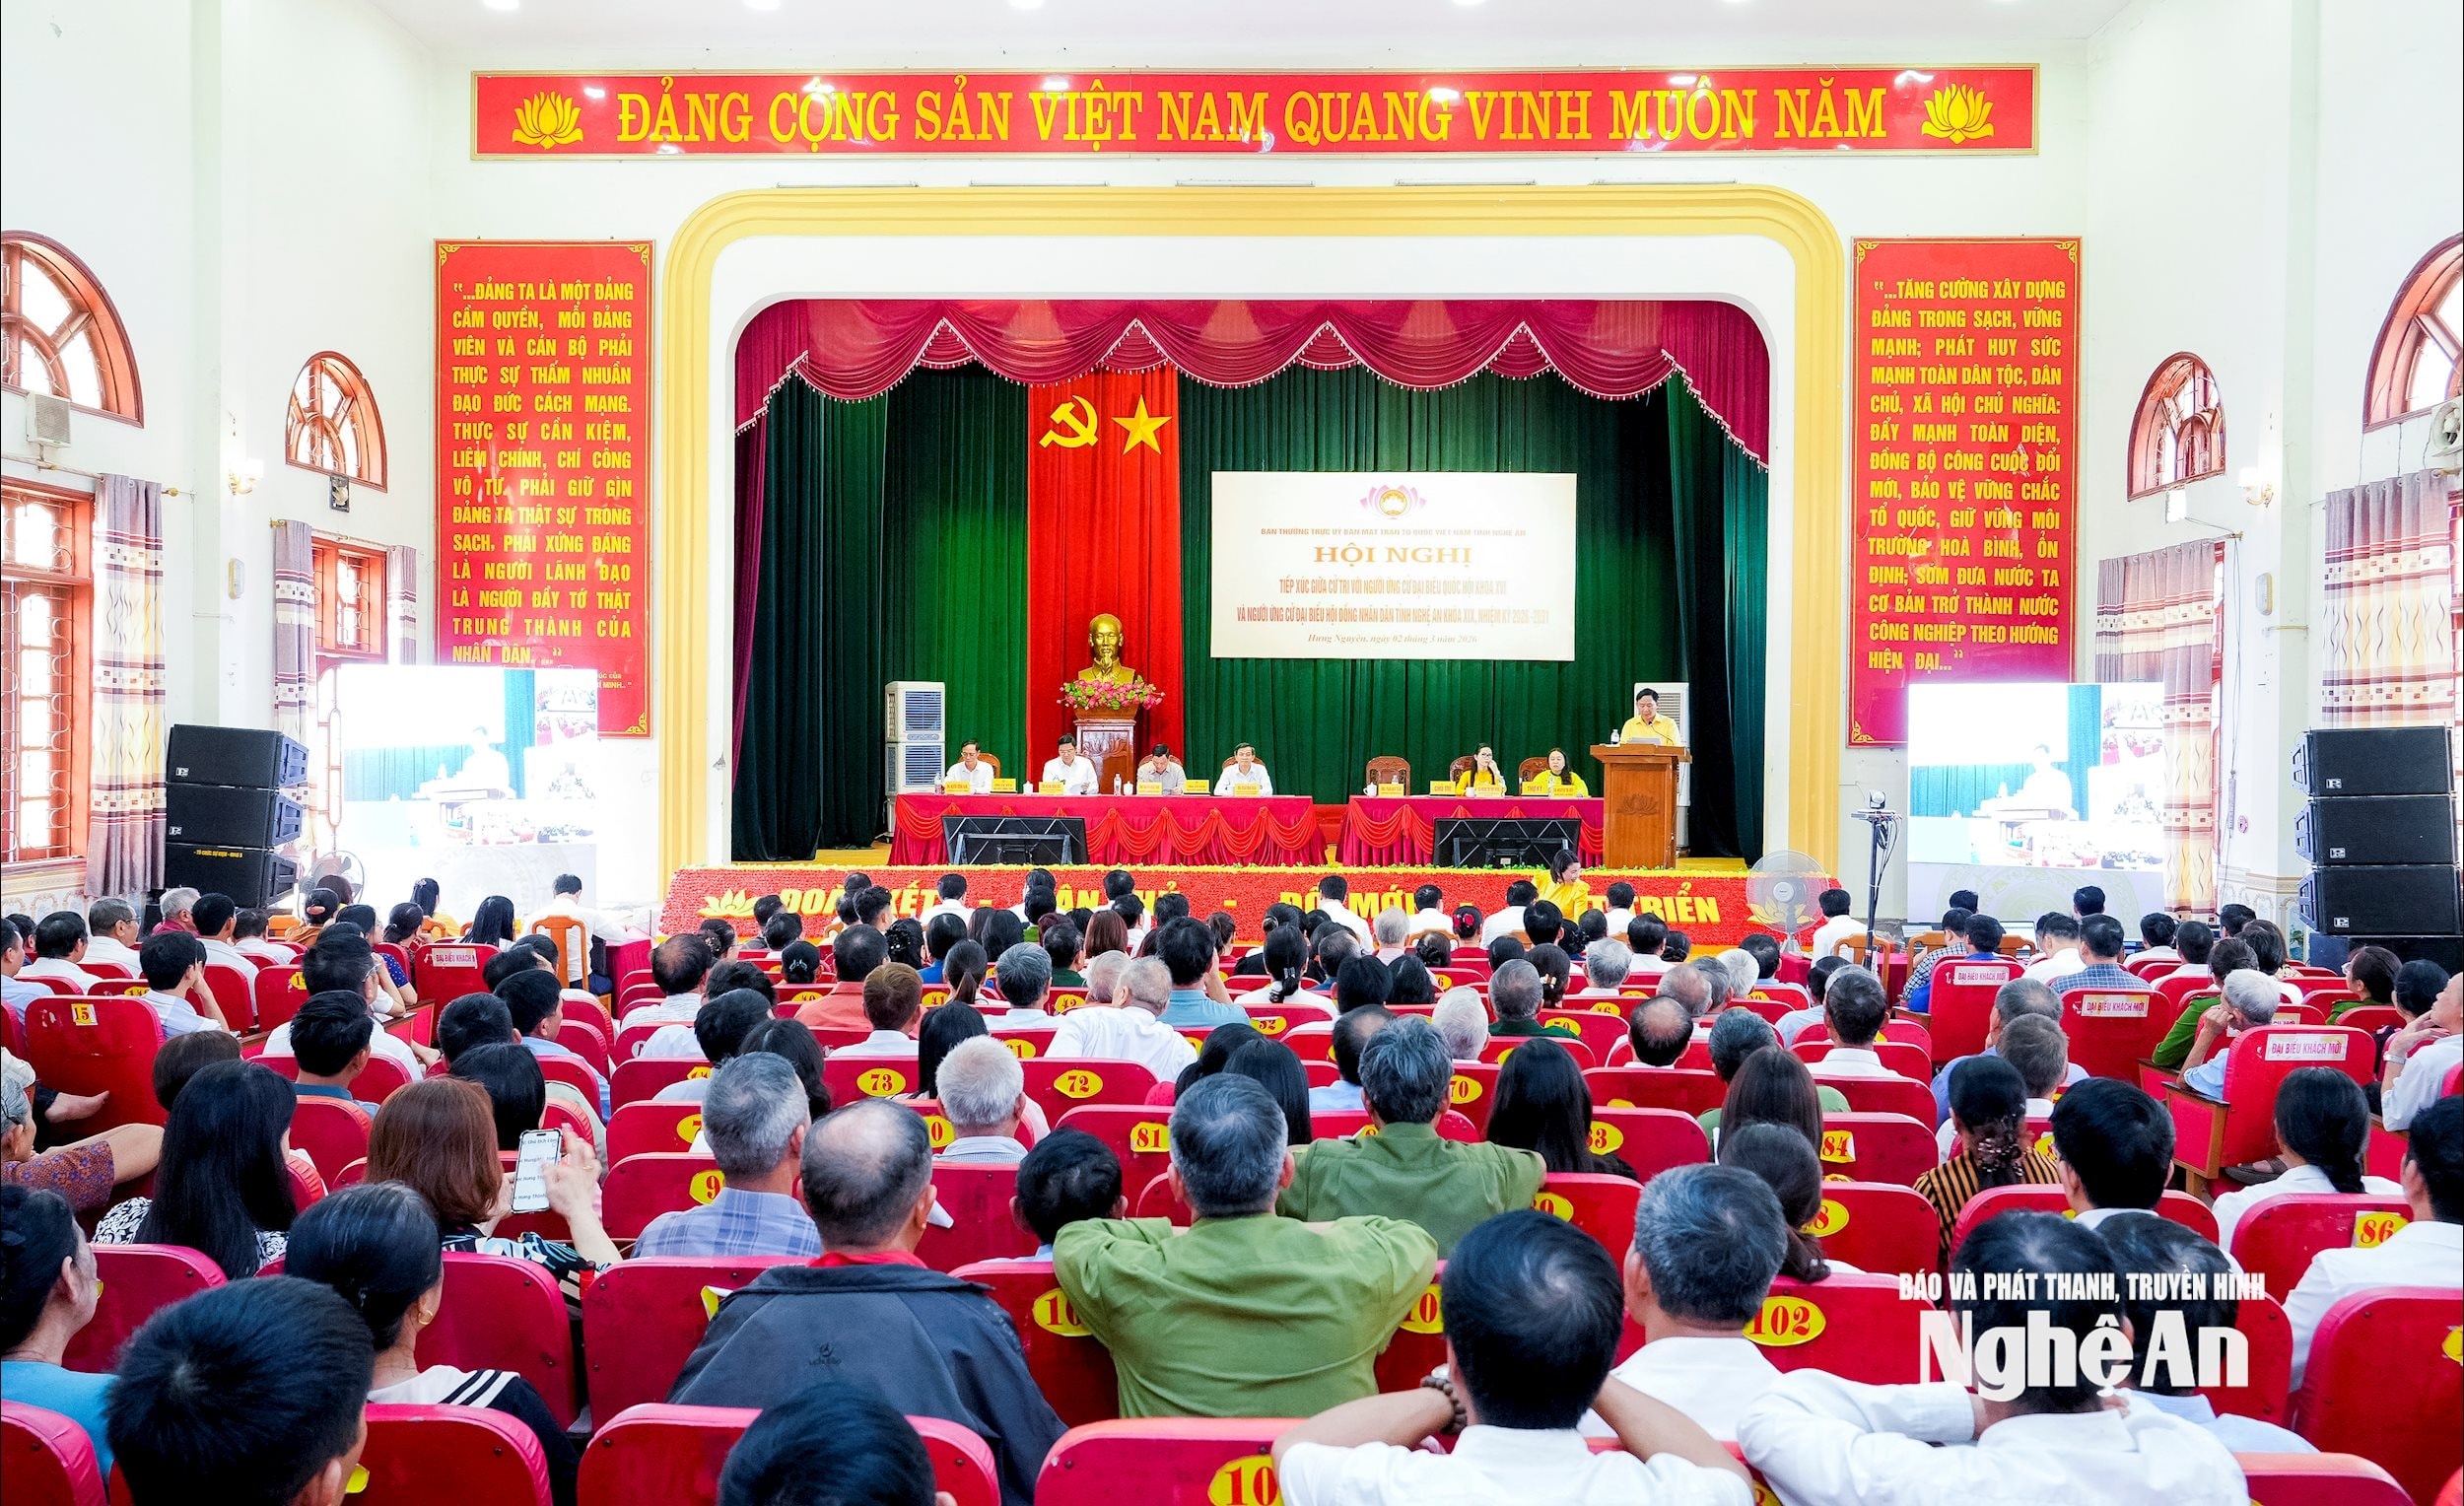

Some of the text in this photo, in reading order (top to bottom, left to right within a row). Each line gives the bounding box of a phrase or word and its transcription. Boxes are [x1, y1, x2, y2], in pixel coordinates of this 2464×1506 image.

[617, 73, 1886, 153] ĐẢNG CỘNG SẢN VIỆT NAM QUANG VINH MUÔN NĂM
[453, 276, 633, 304] “...ĐẢNG TA LÀ MỘT ĐẢNG
[1875, 278, 2065, 302] “...TĂNG CƯỜNG XÂY DỰNG
[453, 303, 632, 330] CẦM QUYỀN, MỖI ĐẢNG
[1872, 304, 2062, 329] ĐẢNG TRONG SẠCH, VỮNG
[453, 332, 632, 359] VIÊN VÀ CÁN BỘ PHẢI
[1872, 334, 2061, 359] MẠNH; PHÁT HUY SỨC
[452, 361, 631, 387] THỰC SỰ THẤM NHUẦN
[1872, 364, 2061, 386] MẠNH TOÀN DÂN TỘC, DÂN
[452, 391, 631, 416] ĐẠO ĐỨC CÁCH MẠNG.
[1871, 392, 2060, 416] CHỦ, XÃ HỘI CHỦ NGHĨA:
[453, 417, 631, 444] THỰC SỰ CẦN KIỆM,
[1870, 417, 2060, 445] ĐẨY MẠNH TOÀN DIỆN,
[453, 447, 632, 469] LIÊM CHÍNH, CHÍ CÔNG
[1870, 447, 2060, 473] ĐỒNG BỘ CÔNG CUỘC ĐỔI
[1313, 542, 1472, 568] HỘI NGHỊ
[1056, 883, 1100, 910] ÂN
[1348, 884, 1416, 918] MỚI
[1634, 882, 1722, 923] TRIỂN
[74, 1006, 90, 1022] 15
[2271, 1040, 2343, 1057] ĐẠI BIỂU KHÁCH MỜI
[870, 1074, 893, 1091] 73
[1067, 1075, 1090, 1092] 72
[1136, 1128, 1161, 1147] 81
[1822, 1135, 1848, 1157] 84
[2361, 1219, 2394, 1244] 86
[1044, 1295, 1082, 1326] 10
[1749, 1305, 1811, 1337] 102
[1225, 1465, 1278, 1506] 10
